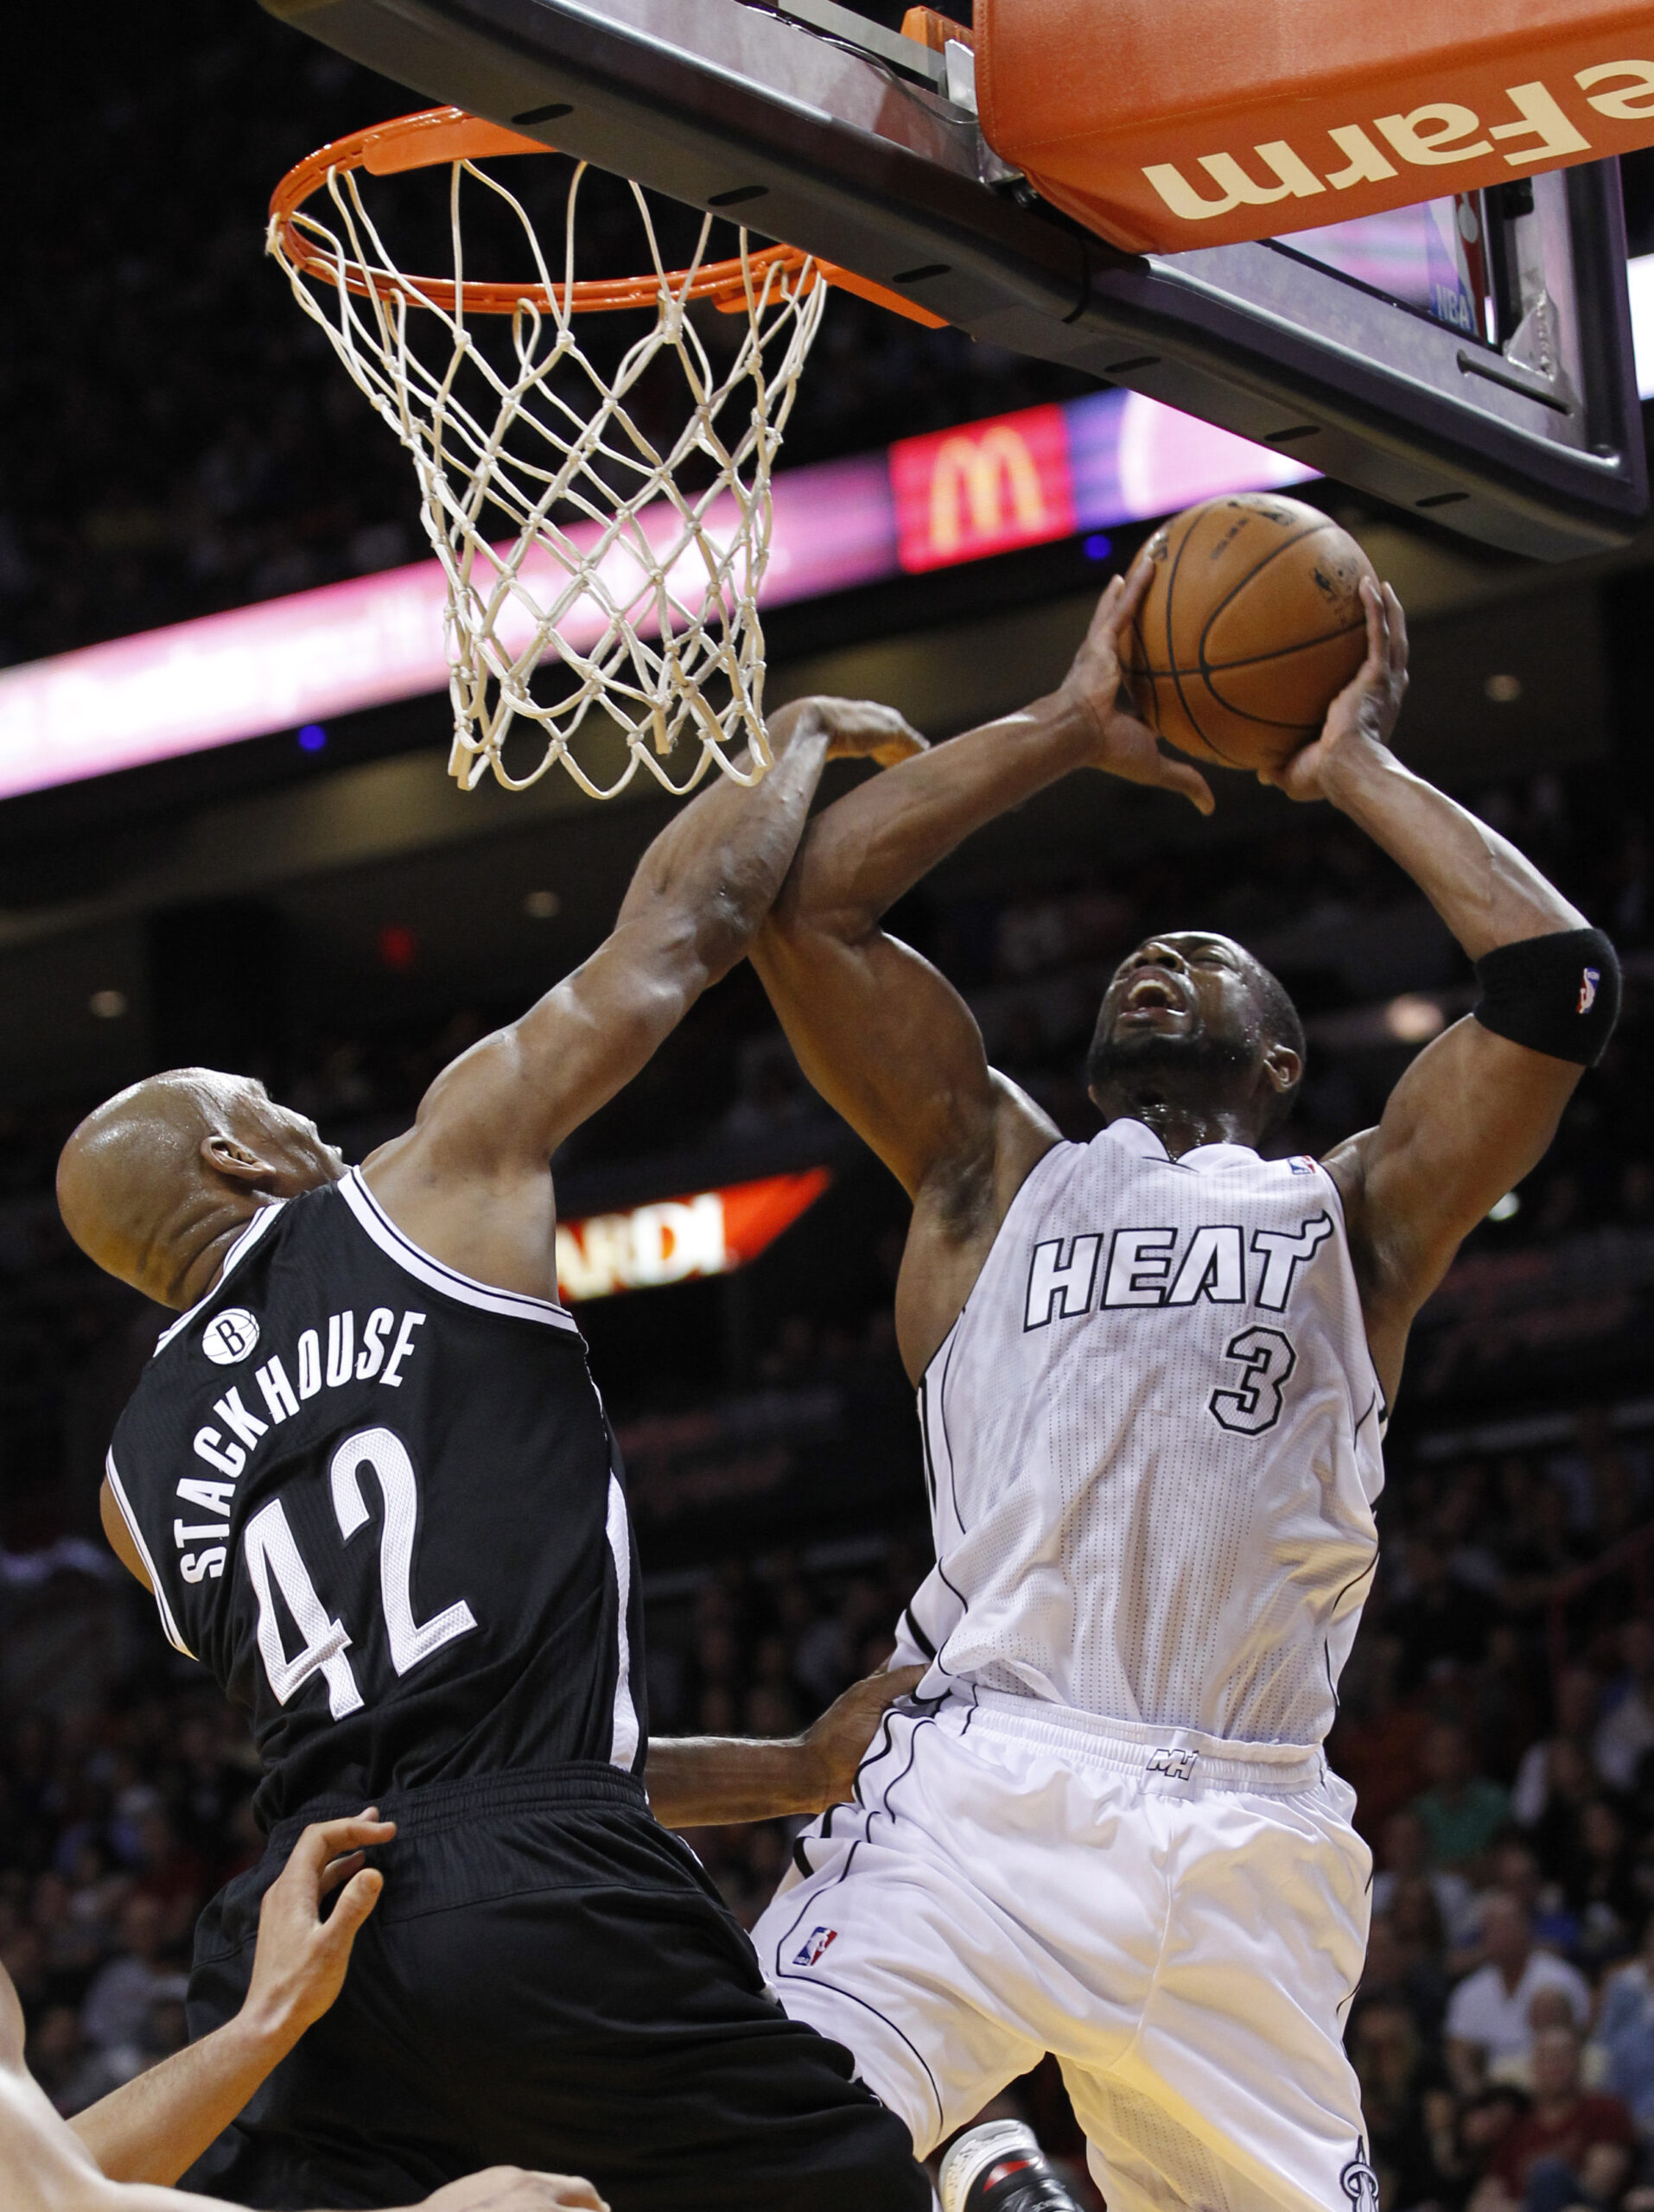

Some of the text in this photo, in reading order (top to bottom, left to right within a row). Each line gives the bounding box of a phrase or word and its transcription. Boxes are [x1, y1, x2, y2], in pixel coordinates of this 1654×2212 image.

[1142, 81, 1592, 219] Farm
[1435, 283, 1473, 331] NBA
[1023, 1210, 1333, 1332] HEAT
[216, 1318, 246, 1357] B
[1208, 1324, 1297, 1438] 3
[174, 1307, 426, 1584] STACKHOUSE
[245, 1427, 478, 1721] 42
